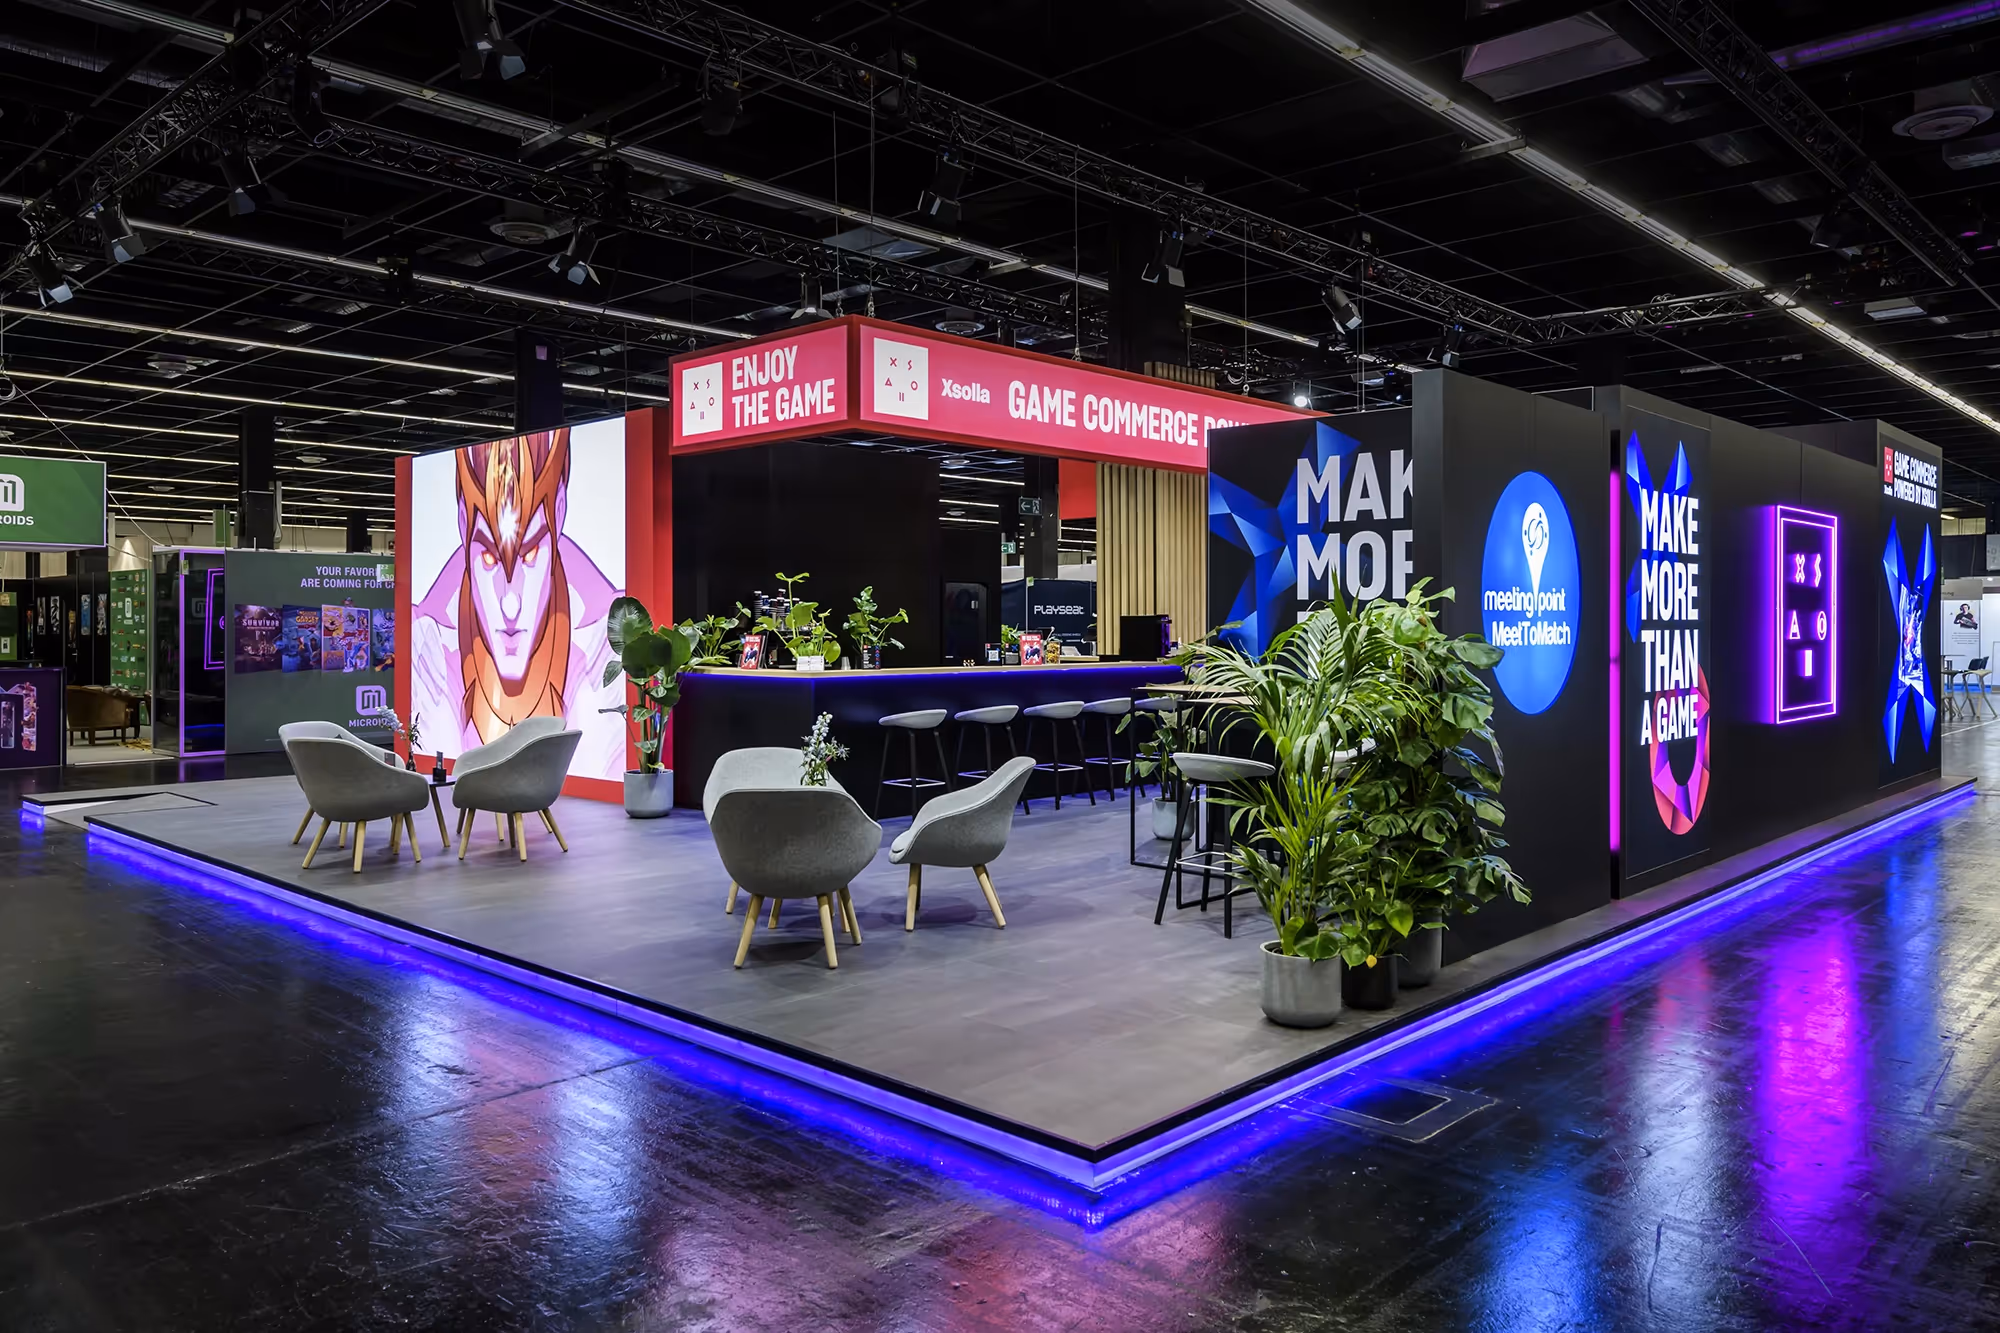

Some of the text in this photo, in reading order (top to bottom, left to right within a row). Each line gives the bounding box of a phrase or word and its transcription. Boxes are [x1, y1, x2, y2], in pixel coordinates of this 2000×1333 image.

[732, 345, 798, 390] ENJOY
[732, 378, 835, 428] THE GAME
[941, 378, 991, 404] Xsolla
[1008, 380, 1076, 428] GAME
[1083, 394, 1198, 447] COMMERCE
[1297, 449, 1413, 524] MAK
[0, 515, 34, 526] OIDS
[1640, 488, 1699, 555] MAKE
[300, 578, 320, 588] ARE
[323, 579, 361, 588] COMING
[364, 579, 382, 589] FOR
[316, 566, 341, 576] YOUR
[1640, 559, 1699, 621] MORE
[1484, 586, 1566, 618] meeting point
[1492, 621, 1571, 646] MeetToMatch
[1640, 629, 1699, 693] THAN
[1640, 693, 1699, 746] A GAME
